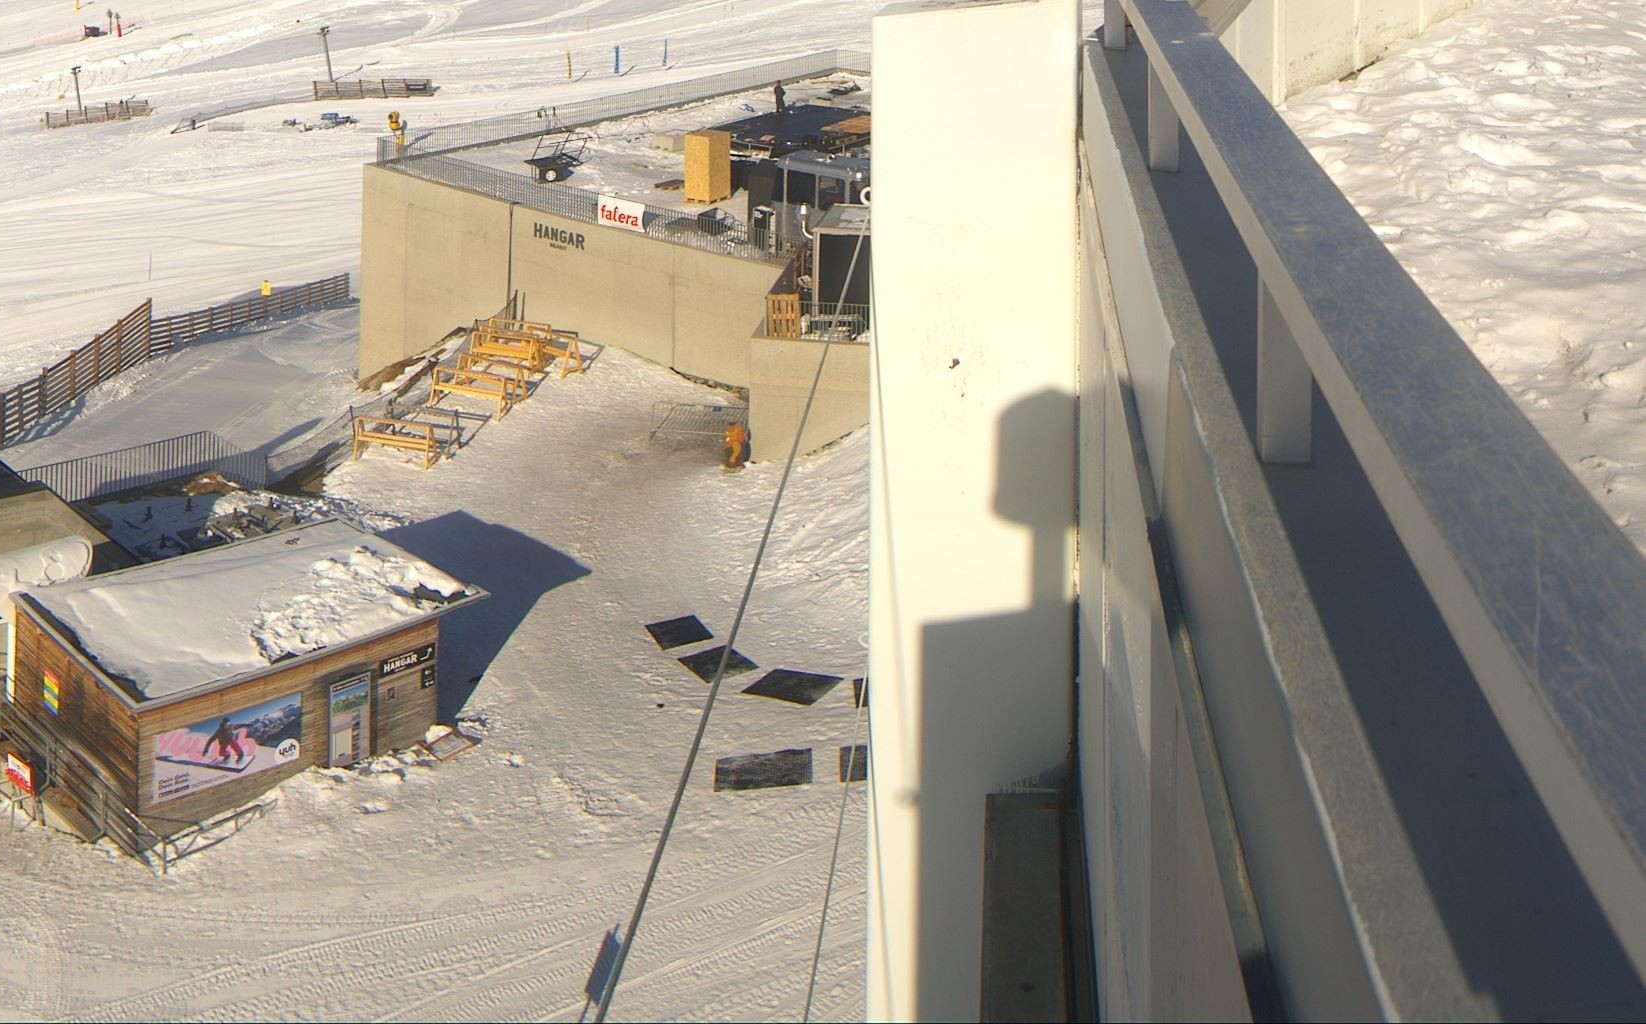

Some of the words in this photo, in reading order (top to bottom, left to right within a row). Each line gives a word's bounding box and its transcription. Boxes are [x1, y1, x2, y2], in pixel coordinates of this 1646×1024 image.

[600, 204, 639, 227] falera
[533, 222, 585, 250] HANGAR
[383, 653, 418, 674] HANGAR
[279, 742, 296, 757] yuh
